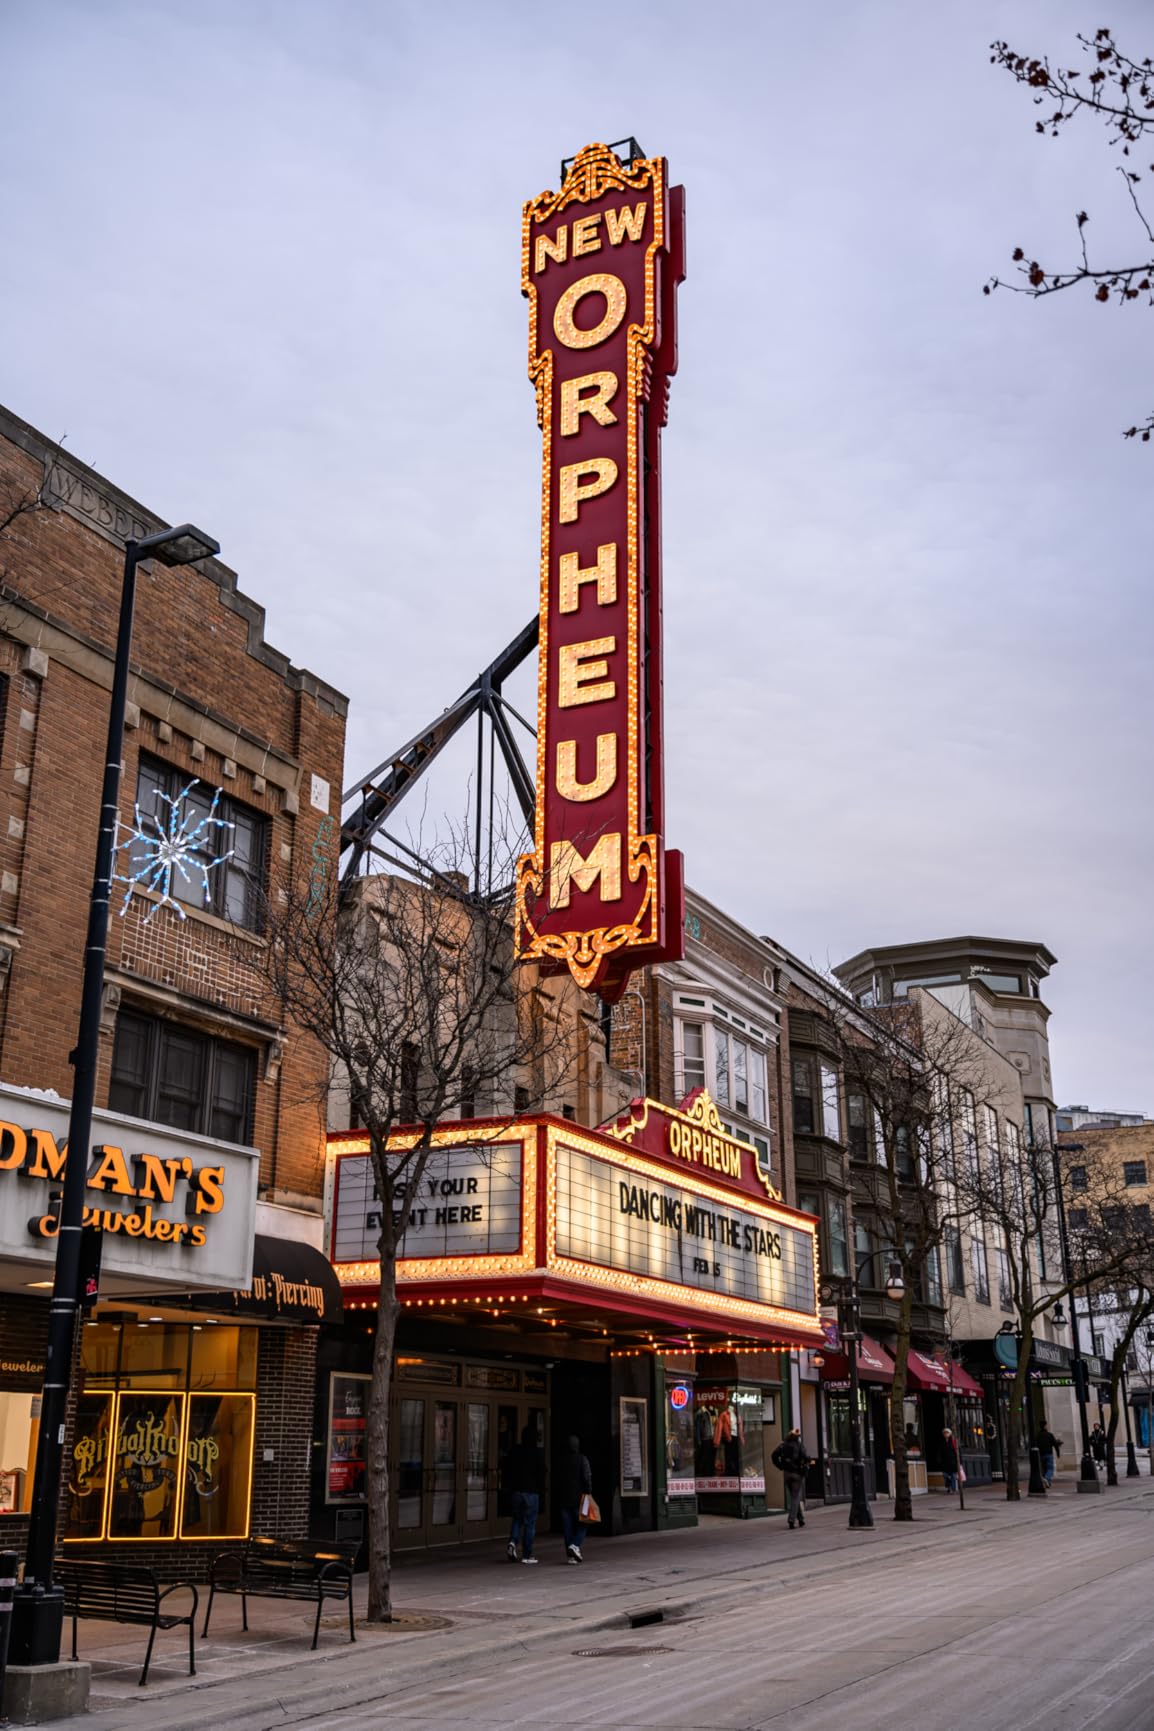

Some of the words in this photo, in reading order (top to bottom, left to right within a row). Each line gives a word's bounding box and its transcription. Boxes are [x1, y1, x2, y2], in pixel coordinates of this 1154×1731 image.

[535, 202, 647, 274] NEW
[550, 273, 627, 909] ORPHEUM
[669, 1120, 742, 1179] ORPHEUM
[427, 1177, 478, 1197] YOUR
[435, 1204, 483, 1225] HERE
[619, 1181, 682, 1231] DANCING
[684, 1204, 716, 1241] WITH
[717, 1212, 741, 1250] THE
[744, 1224, 782, 1260] STARS
[693, 1257, 709, 1275] FEB
[270, 1272, 324, 1318] Piercing
